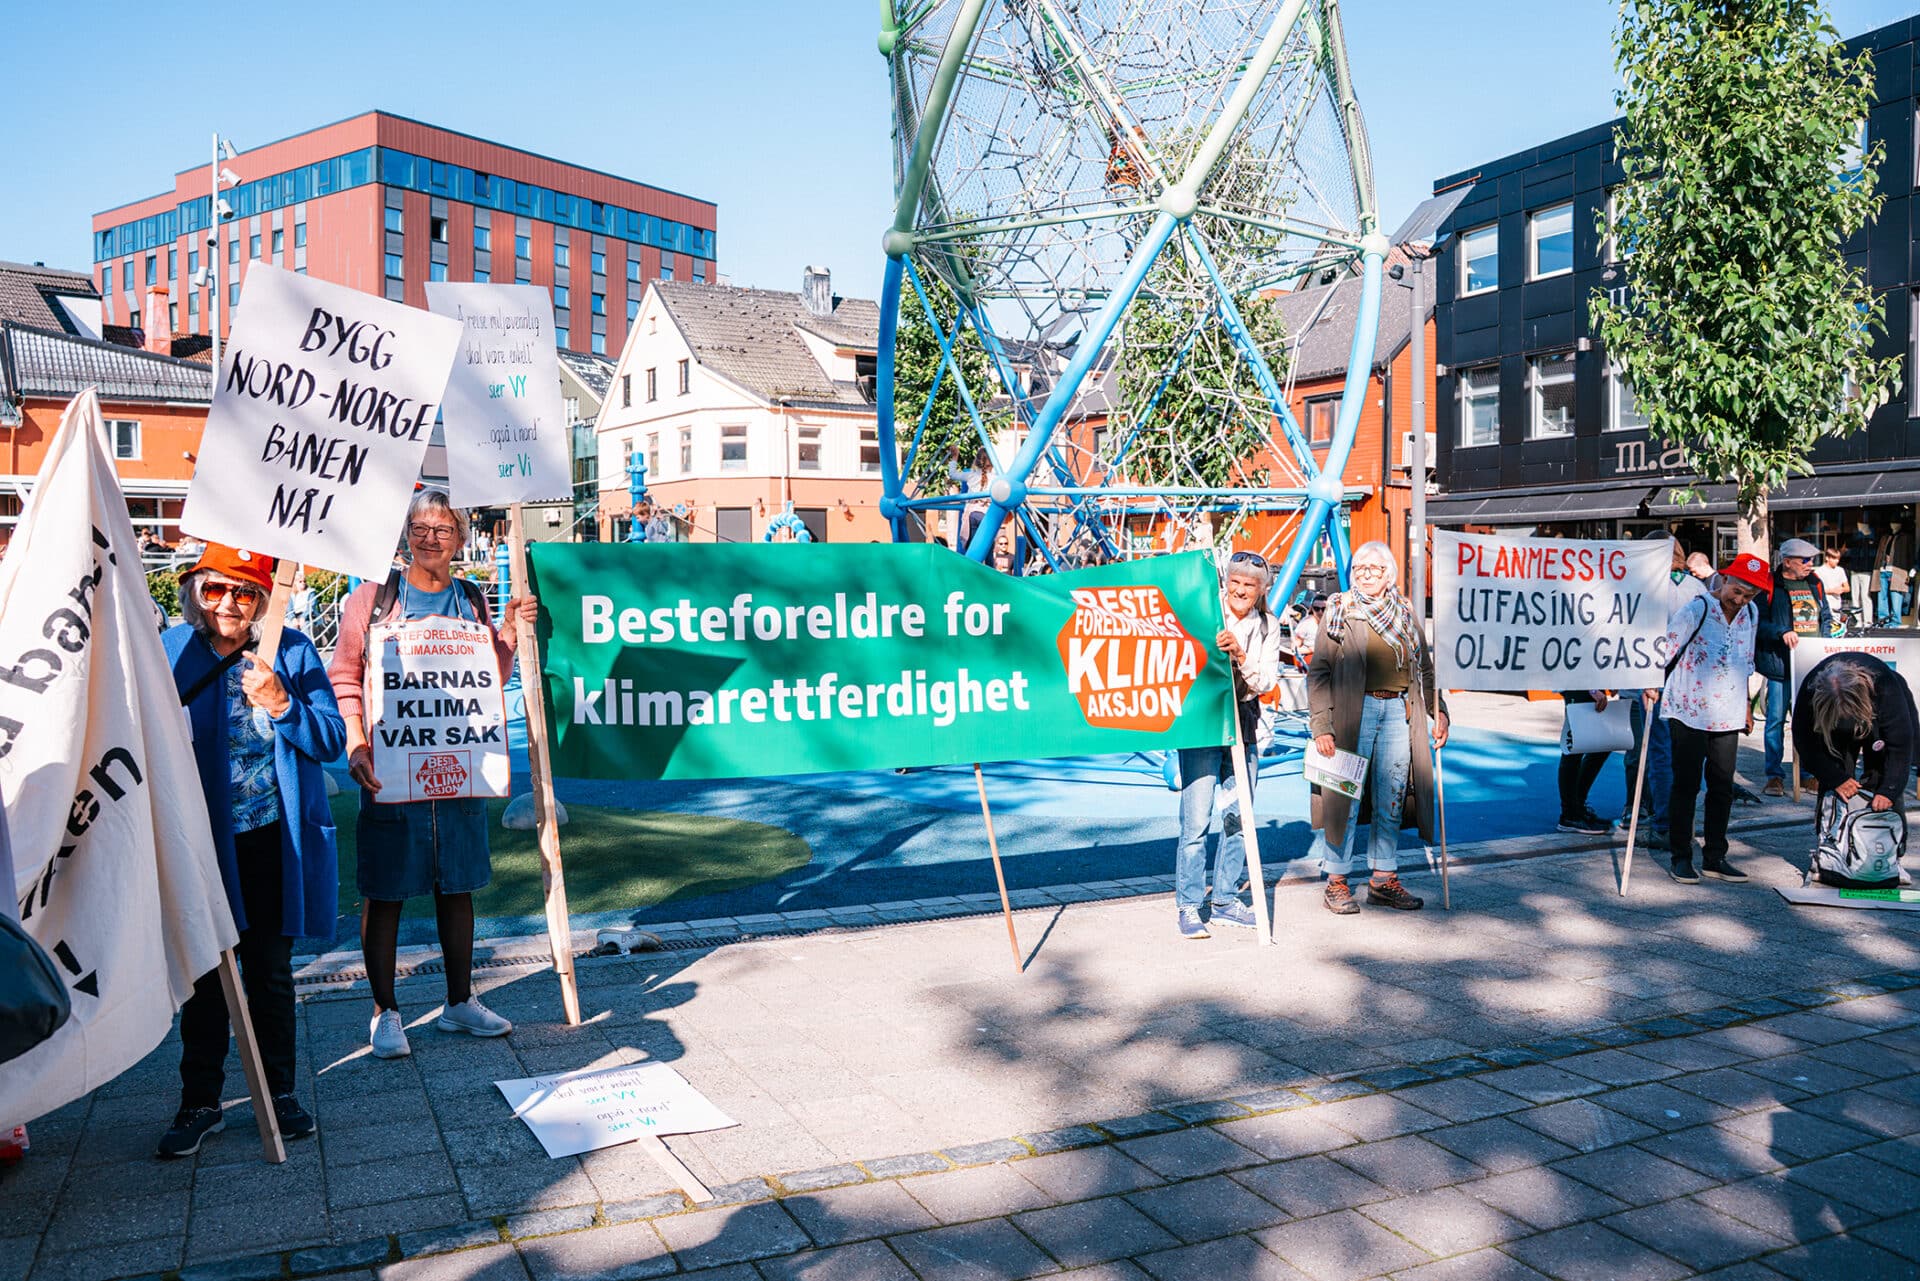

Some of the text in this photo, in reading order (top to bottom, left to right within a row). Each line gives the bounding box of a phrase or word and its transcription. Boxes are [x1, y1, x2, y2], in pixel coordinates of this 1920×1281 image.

[299, 307, 396, 370] BYGG
[225, 349, 436, 442] NORD-NORGE
[488, 375, 528, 399] sier VY
[261, 423, 369, 486] BANEN
[498, 452, 533, 479] sier Vi
[267, 483, 334, 534] NÅ!
[581, 591, 1011, 644] Besteforeldre for
[1069, 589, 1161, 619] BESTE
[1607, 592, 1642, 625] AV
[1074, 609, 1184, 639] FORELDRENES
[395, 644, 475, 656] KLIMAAKSJON
[1454, 633, 1667, 671] OLJE OG GASS
[1863, 645, 1896, 654] EARTH
[383, 670, 492, 691] BARNAS
[1068, 638, 1197, 694] KLIMA
[397, 698, 483, 719] KLIMA
[572, 668, 1030, 727] klimarettferdighet
[1087, 686, 1182, 718] AKSJON
[379, 725, 502, 748] VÅR SAK
[419, 772, 465, 788] KLIMA
